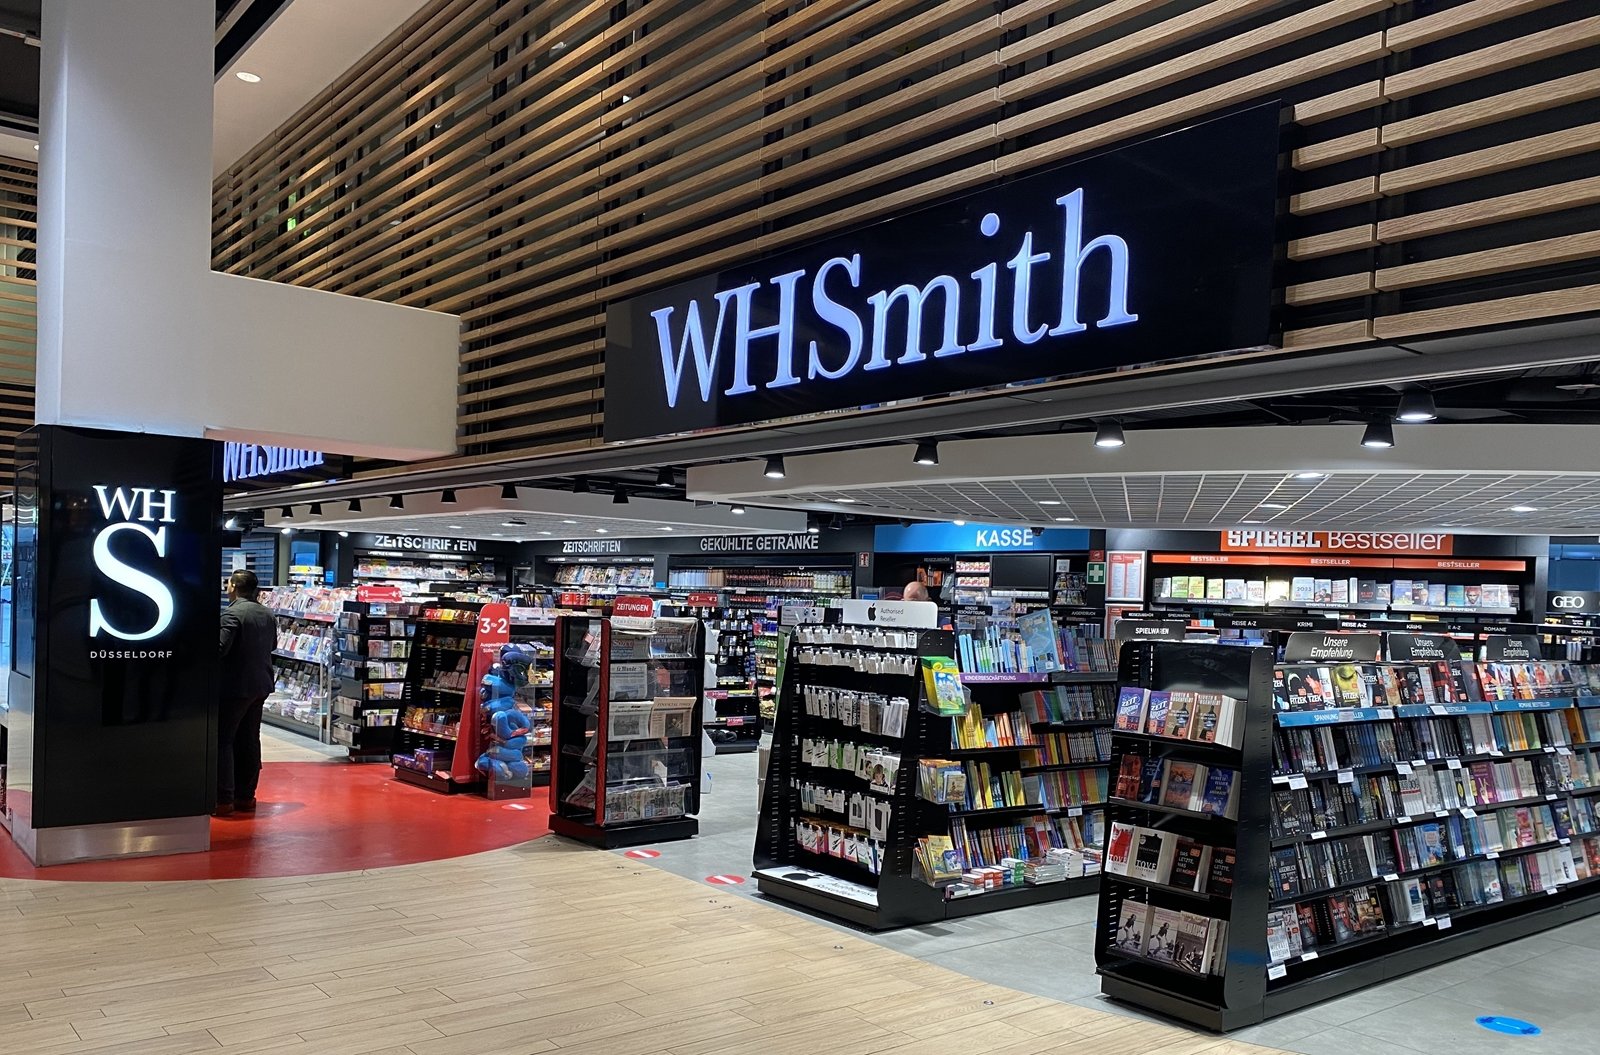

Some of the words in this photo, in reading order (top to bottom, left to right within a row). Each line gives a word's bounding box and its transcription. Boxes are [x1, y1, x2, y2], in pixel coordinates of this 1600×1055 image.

[650, 187, 1138, 408] WHSmith
[224, 441, 324, 482] WHSm
[92, 485, 176, 523] WH
[700, 535, 753, 551] GEKÜHLTE
[756, 534, 819, 550] GETRÄNKE
[976, 529, 1034, 547] KASSE
[1228, 530, 1321, 548] SPIEGEL
[1328, 531, 1447, 550] Bestseller
[562, 540, 621, 553] ZEITSCHRIFTEN
[89, 522, 174, 641] S
[616, 603, 649, 612] ZEITUNGEN
[1552, 595, 1585, 609] GEO
[480, 617, 491, 634] 3
[497, 617, 507, 634] 2
[1322, 637, 1348, 647] Unsere
[1414, 637, 1433, 647] Unsere
[1508, 638, 1522, 647] Unsere
[90, 649, 173, 659] DÜSSELDORF
[1310, 647, 1353, 659] Empfehlung
[1410, 647, 1444, 658] Empfehlung
[1503, 648, 1529, 658] Empfehlung
[1314, 713, 1339, 722] SPANNUNG
[1109, 854, 1127, 863] TOVE
[1136, 859, 1157, 870] TOVE
